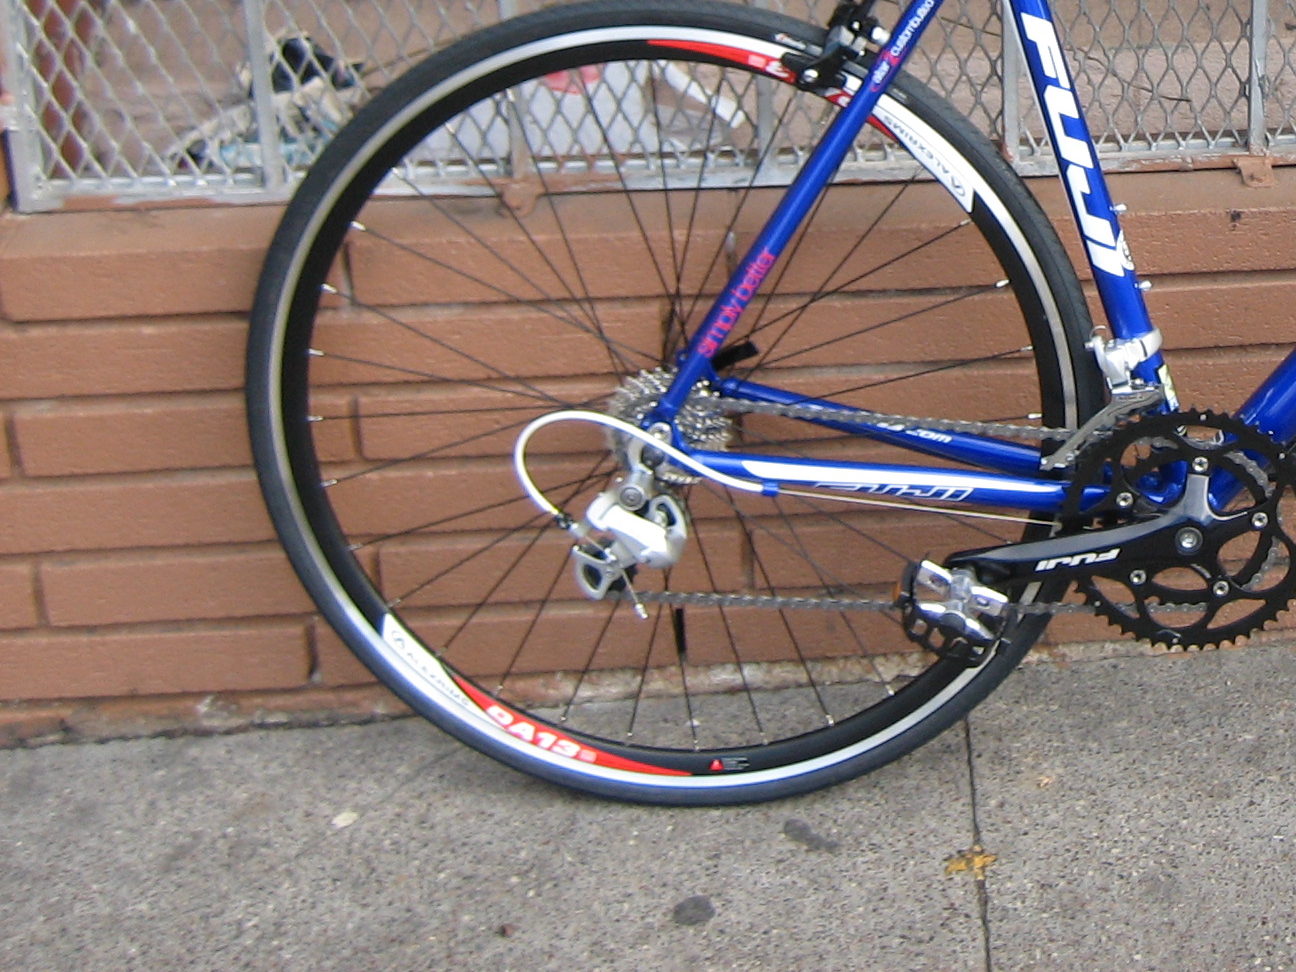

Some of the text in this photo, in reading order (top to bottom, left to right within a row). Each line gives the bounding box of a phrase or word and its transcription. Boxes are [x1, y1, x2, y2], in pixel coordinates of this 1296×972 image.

[1021, 12, 1125, 277] FUJI
[1034, 547, 1121, 572] FUJI
[486, 705, 581, 759] DA13
